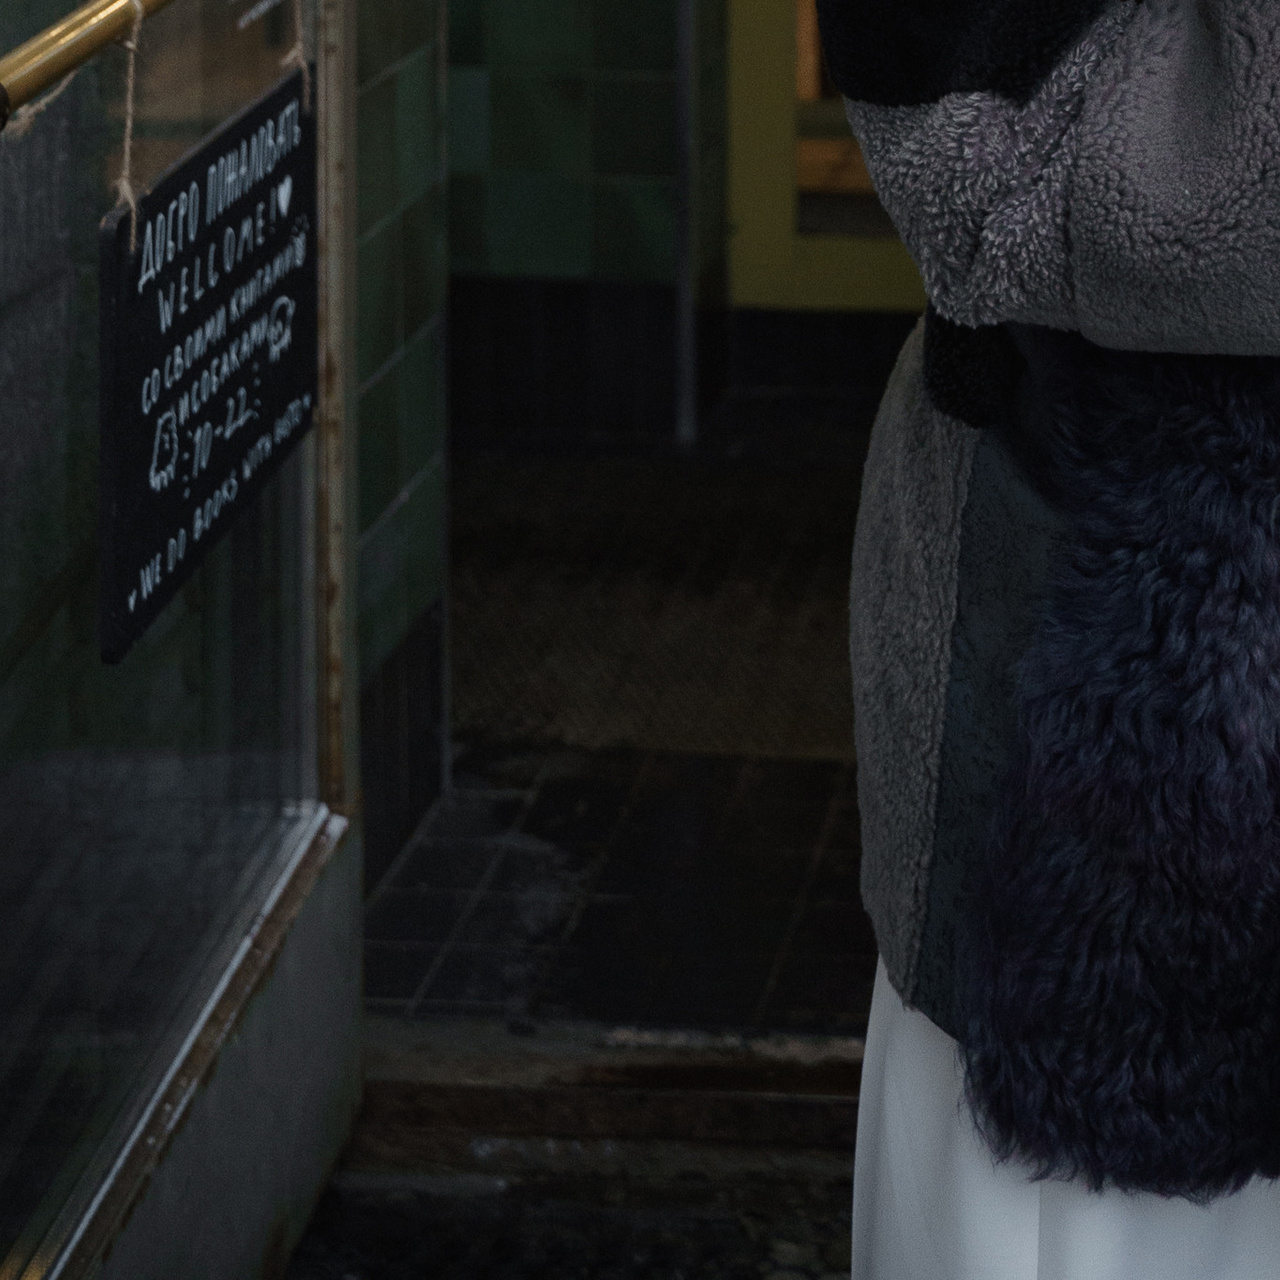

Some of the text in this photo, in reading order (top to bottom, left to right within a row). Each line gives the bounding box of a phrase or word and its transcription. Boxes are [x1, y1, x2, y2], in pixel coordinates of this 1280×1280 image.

[138, 98, 301, 293] ДОБРО ПОЖАЛОВАТЬ
[142, 240, 297, 415] СО СВОИМИ КНИГАМИ
[192, 387, 257, 478] 10-22
[140, 552, 162, 601] WE
[167, 527, 187, 574] DO
